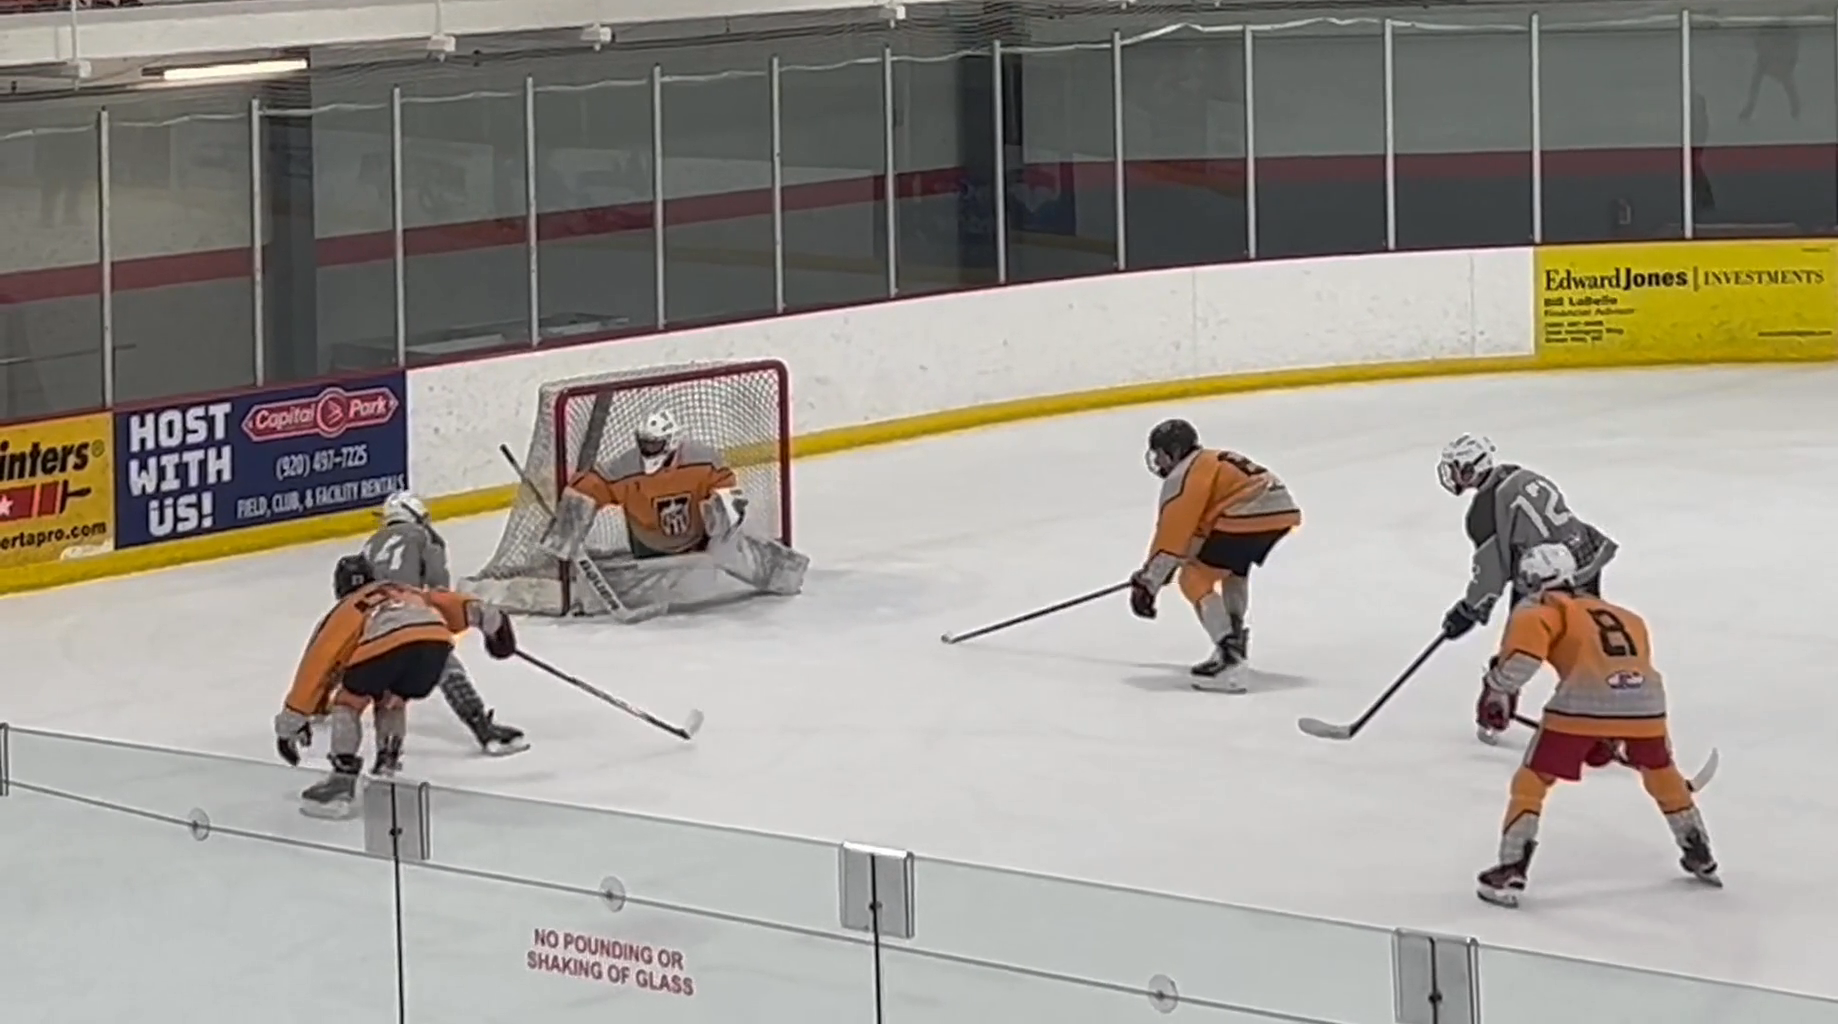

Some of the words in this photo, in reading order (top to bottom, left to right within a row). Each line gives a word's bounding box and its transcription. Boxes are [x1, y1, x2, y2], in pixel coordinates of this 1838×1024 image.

[1703, 269, 1825, 286] INVESTMENTS
[129, 402, 232, 453] HOST
[255, 403, 316, 430] Capital
[349, 396, 387, 418] Park
[128, 445, 232, 496] WITH
[276, 454, 311, 480] (920)
[312, 444, 368, 472] 497-7225
[148, 491, 213, 536] US!
[237, 496, 271, 519] FIELD,
[272, 490, 304, 513] CLUB,
[315, 480, 360, 505] FACILITY
[360, 473, 405, 498] RENTALS
[1510, 479, 1573, 538] 12
[0, 521, 107, 550] ertapro.com
[1586, 608, 1638, 657] 8
[534, 928, 559, 949] NO
[563, 933, 654, 965] POUNDING
[657, 949, 684, 971] OR
[527, 950, 603, 980] SHAKING
[607, 964, 630, 985] OF
[635, 969, 695, 996] GLASS
